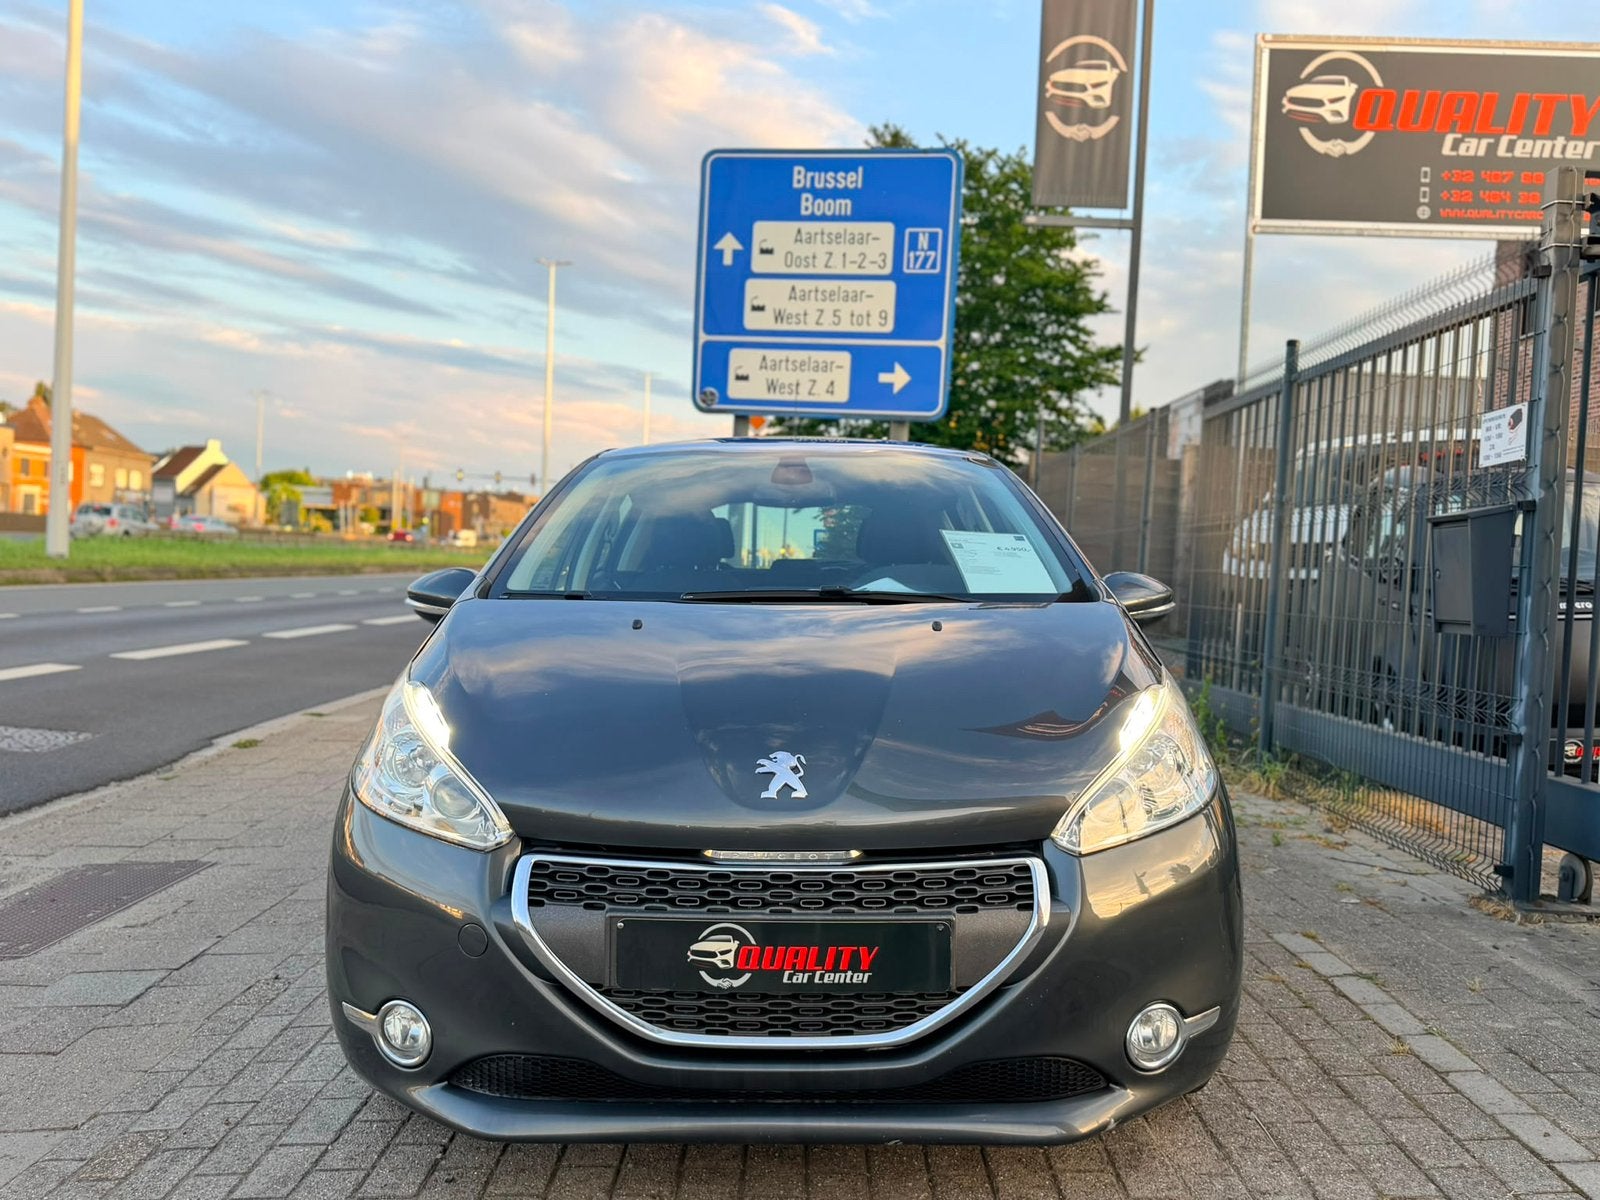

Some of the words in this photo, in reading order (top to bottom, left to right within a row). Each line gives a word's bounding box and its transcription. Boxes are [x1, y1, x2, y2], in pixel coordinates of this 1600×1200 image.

[1352, 88, 1600, 136] QUALITY
[1441, 133, 1494, 157] Car
[1496, 134, 1600, 160] Center
[792, 166, 863, 190] Brussel
[1442, 169, 1475, 184] +32
[800, 193, 852, 216] Boom
[1441, 189, 1474, 203] +32
[1440, 208, 1544, 220] WWW.QUALITYCARC
[794, 227, 880, 246] Aartselaar-
[918, 232, 929, 250] N
[784, 251, 817, 269] Oost
[909, 252, 936, 270] 177
[788, 285, 875, 303] Aartselaar-
[773, 308, 808, 326] West
[850, 309, 872, 327] tot
[878, 309, 889, 327] 9
[759, 355, 844, 374] Aartselaar-
[766, 378, 801, 396] West
[737, 944, 879, 971] QUALITY
[783, 971, 812, 984] Car
[814, 970, 873, 984] Center
